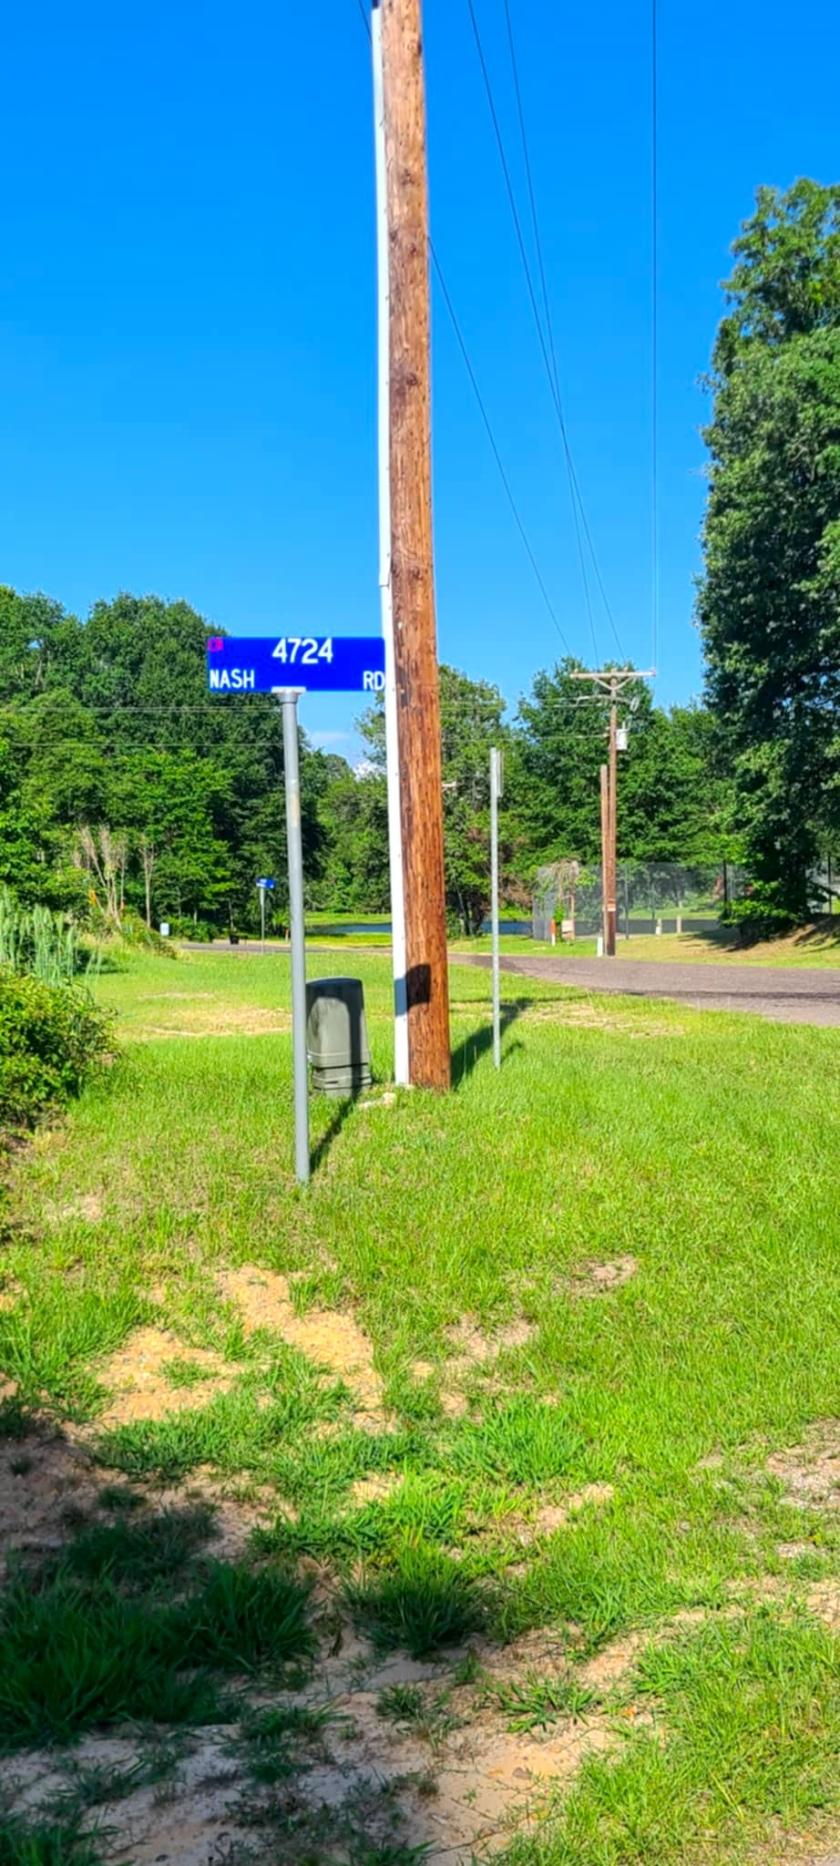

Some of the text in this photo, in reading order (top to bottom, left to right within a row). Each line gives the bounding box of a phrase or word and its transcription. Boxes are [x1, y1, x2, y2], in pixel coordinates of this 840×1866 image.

[271, 637, 334, 664] 4724
[209, 668, 386, 691] NASH RD
